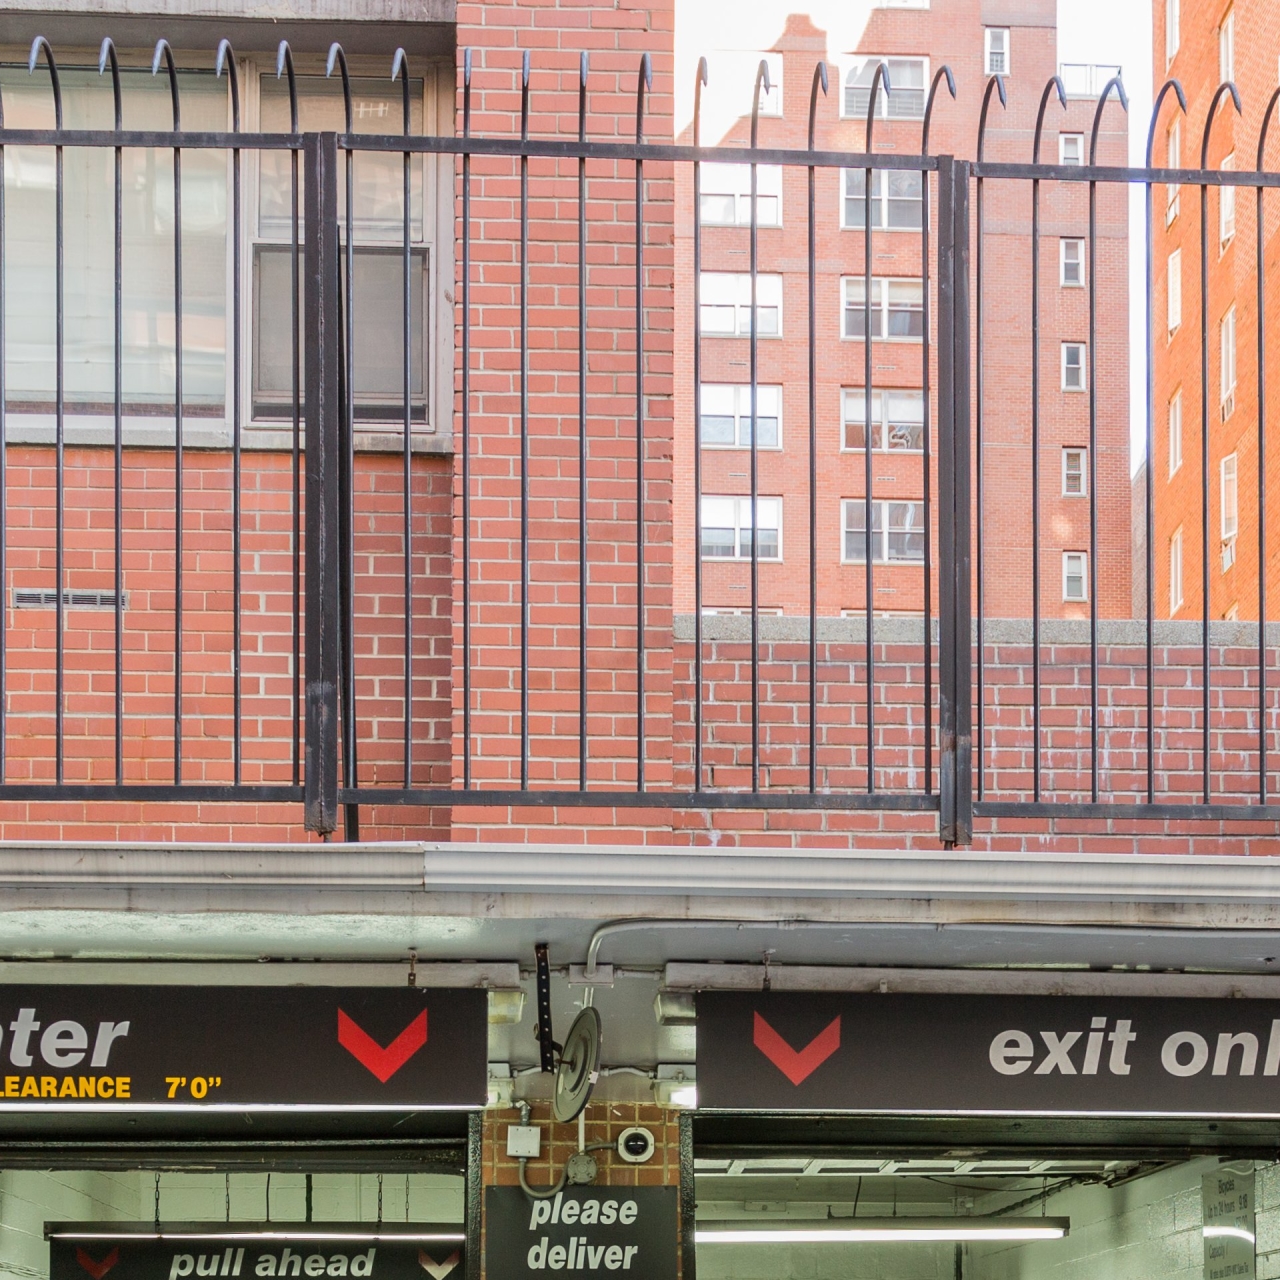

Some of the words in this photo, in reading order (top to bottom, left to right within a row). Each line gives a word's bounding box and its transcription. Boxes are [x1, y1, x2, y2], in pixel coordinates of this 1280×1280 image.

[989, 1017, 1136, 1076] exit
[529, 1192, 638, 1230] please
[255, 1248, 376, 1277] ahead
[527, 1237, 638, 1270] deliver
